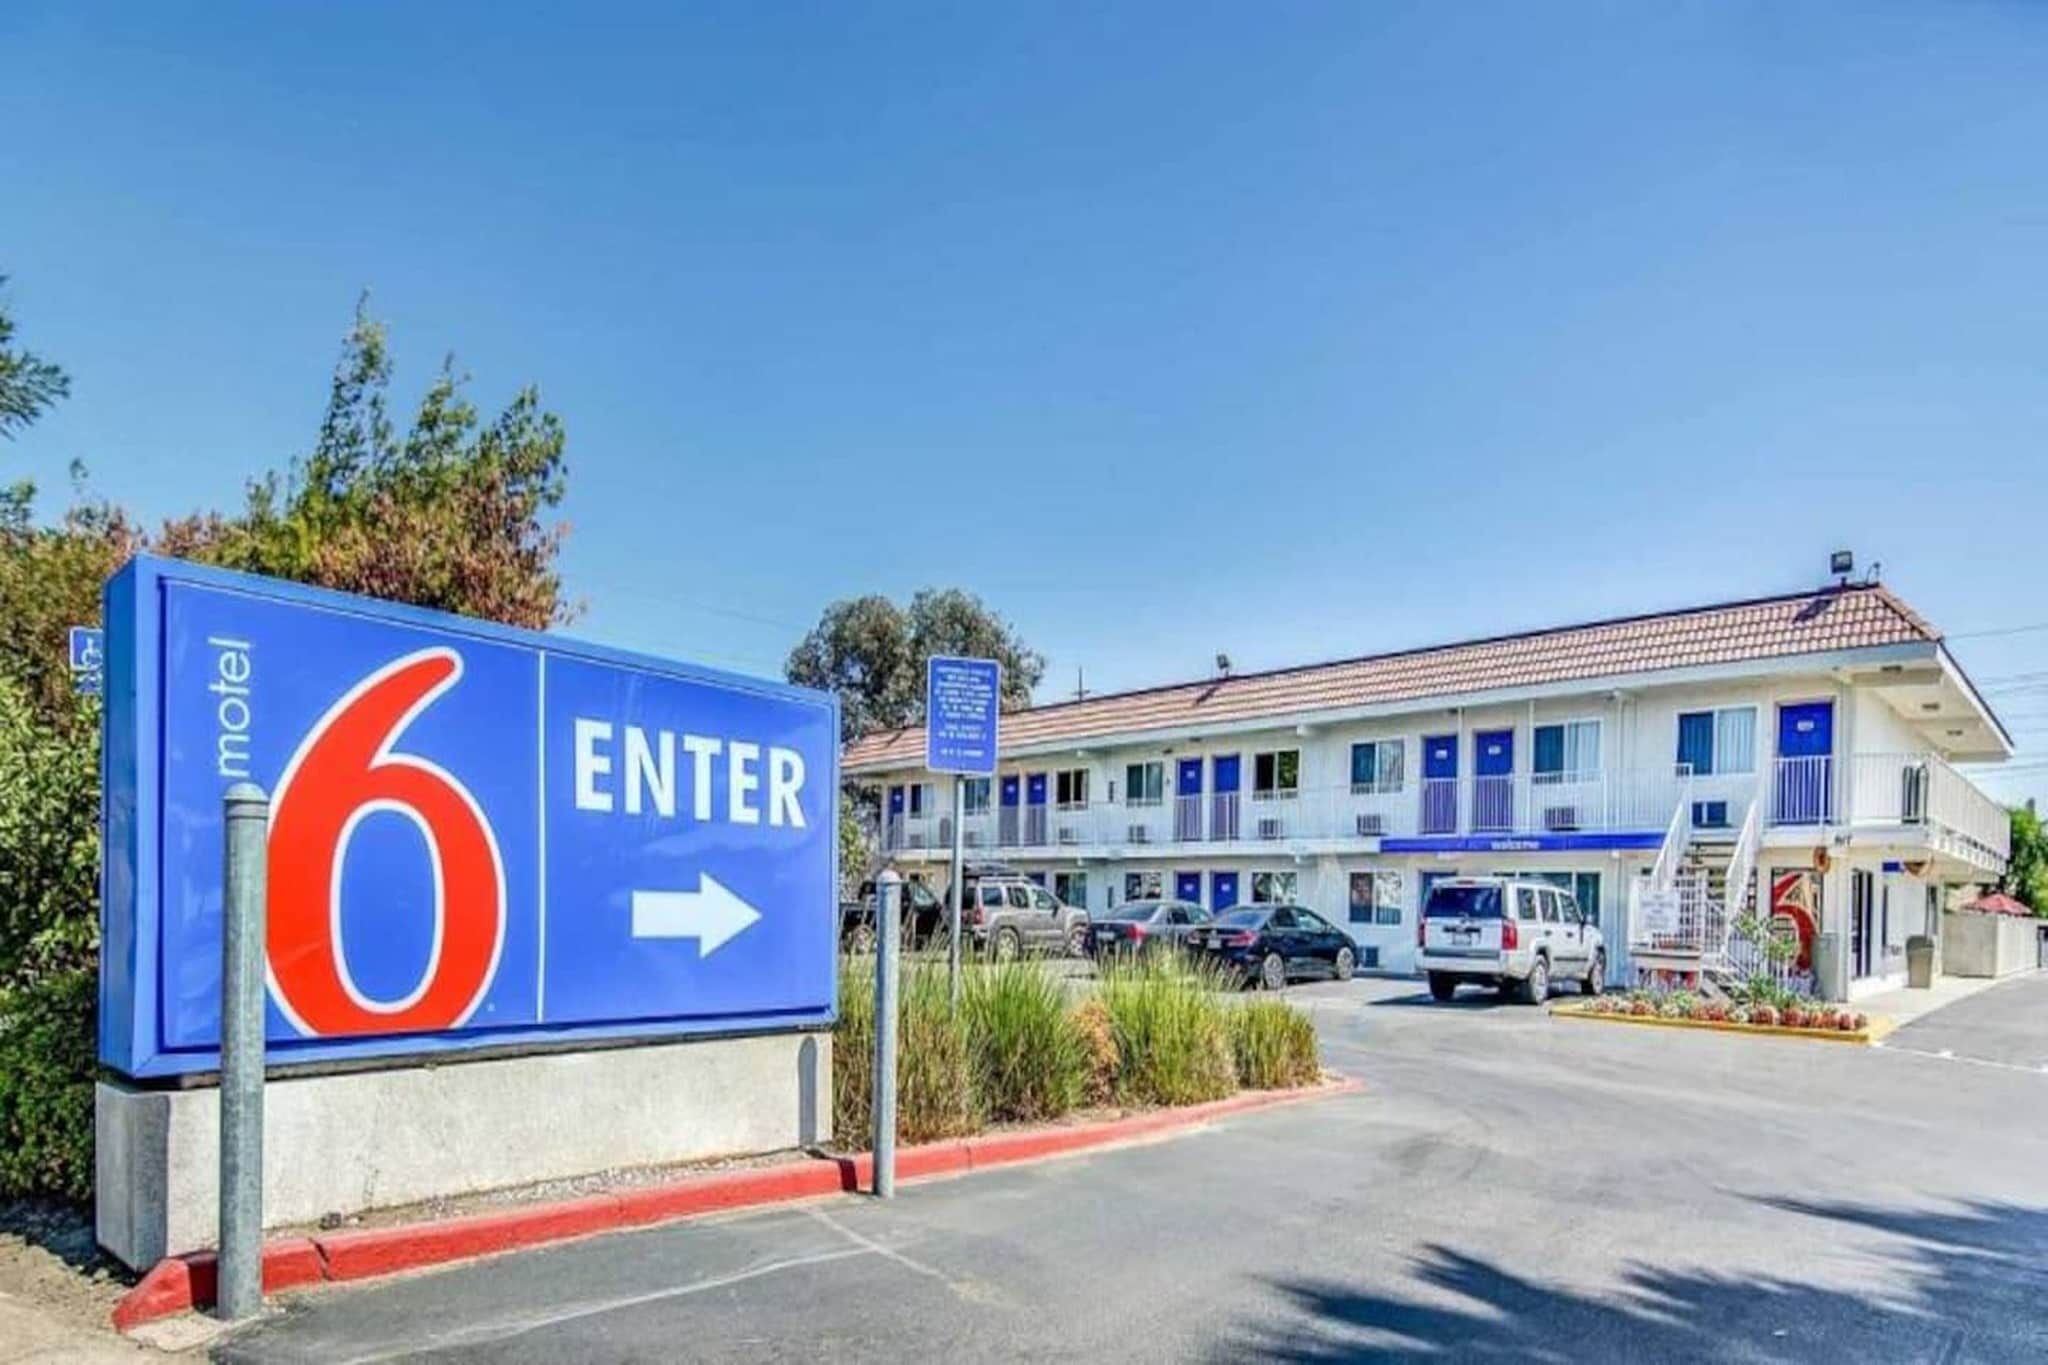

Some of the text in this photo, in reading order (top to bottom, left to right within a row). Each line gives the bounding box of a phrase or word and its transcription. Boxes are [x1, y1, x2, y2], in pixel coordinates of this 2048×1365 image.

[207, 636, 251, 777] motel
[574, 718, 808, 828] ENTER
[265, 647, 506, 1037] 6
